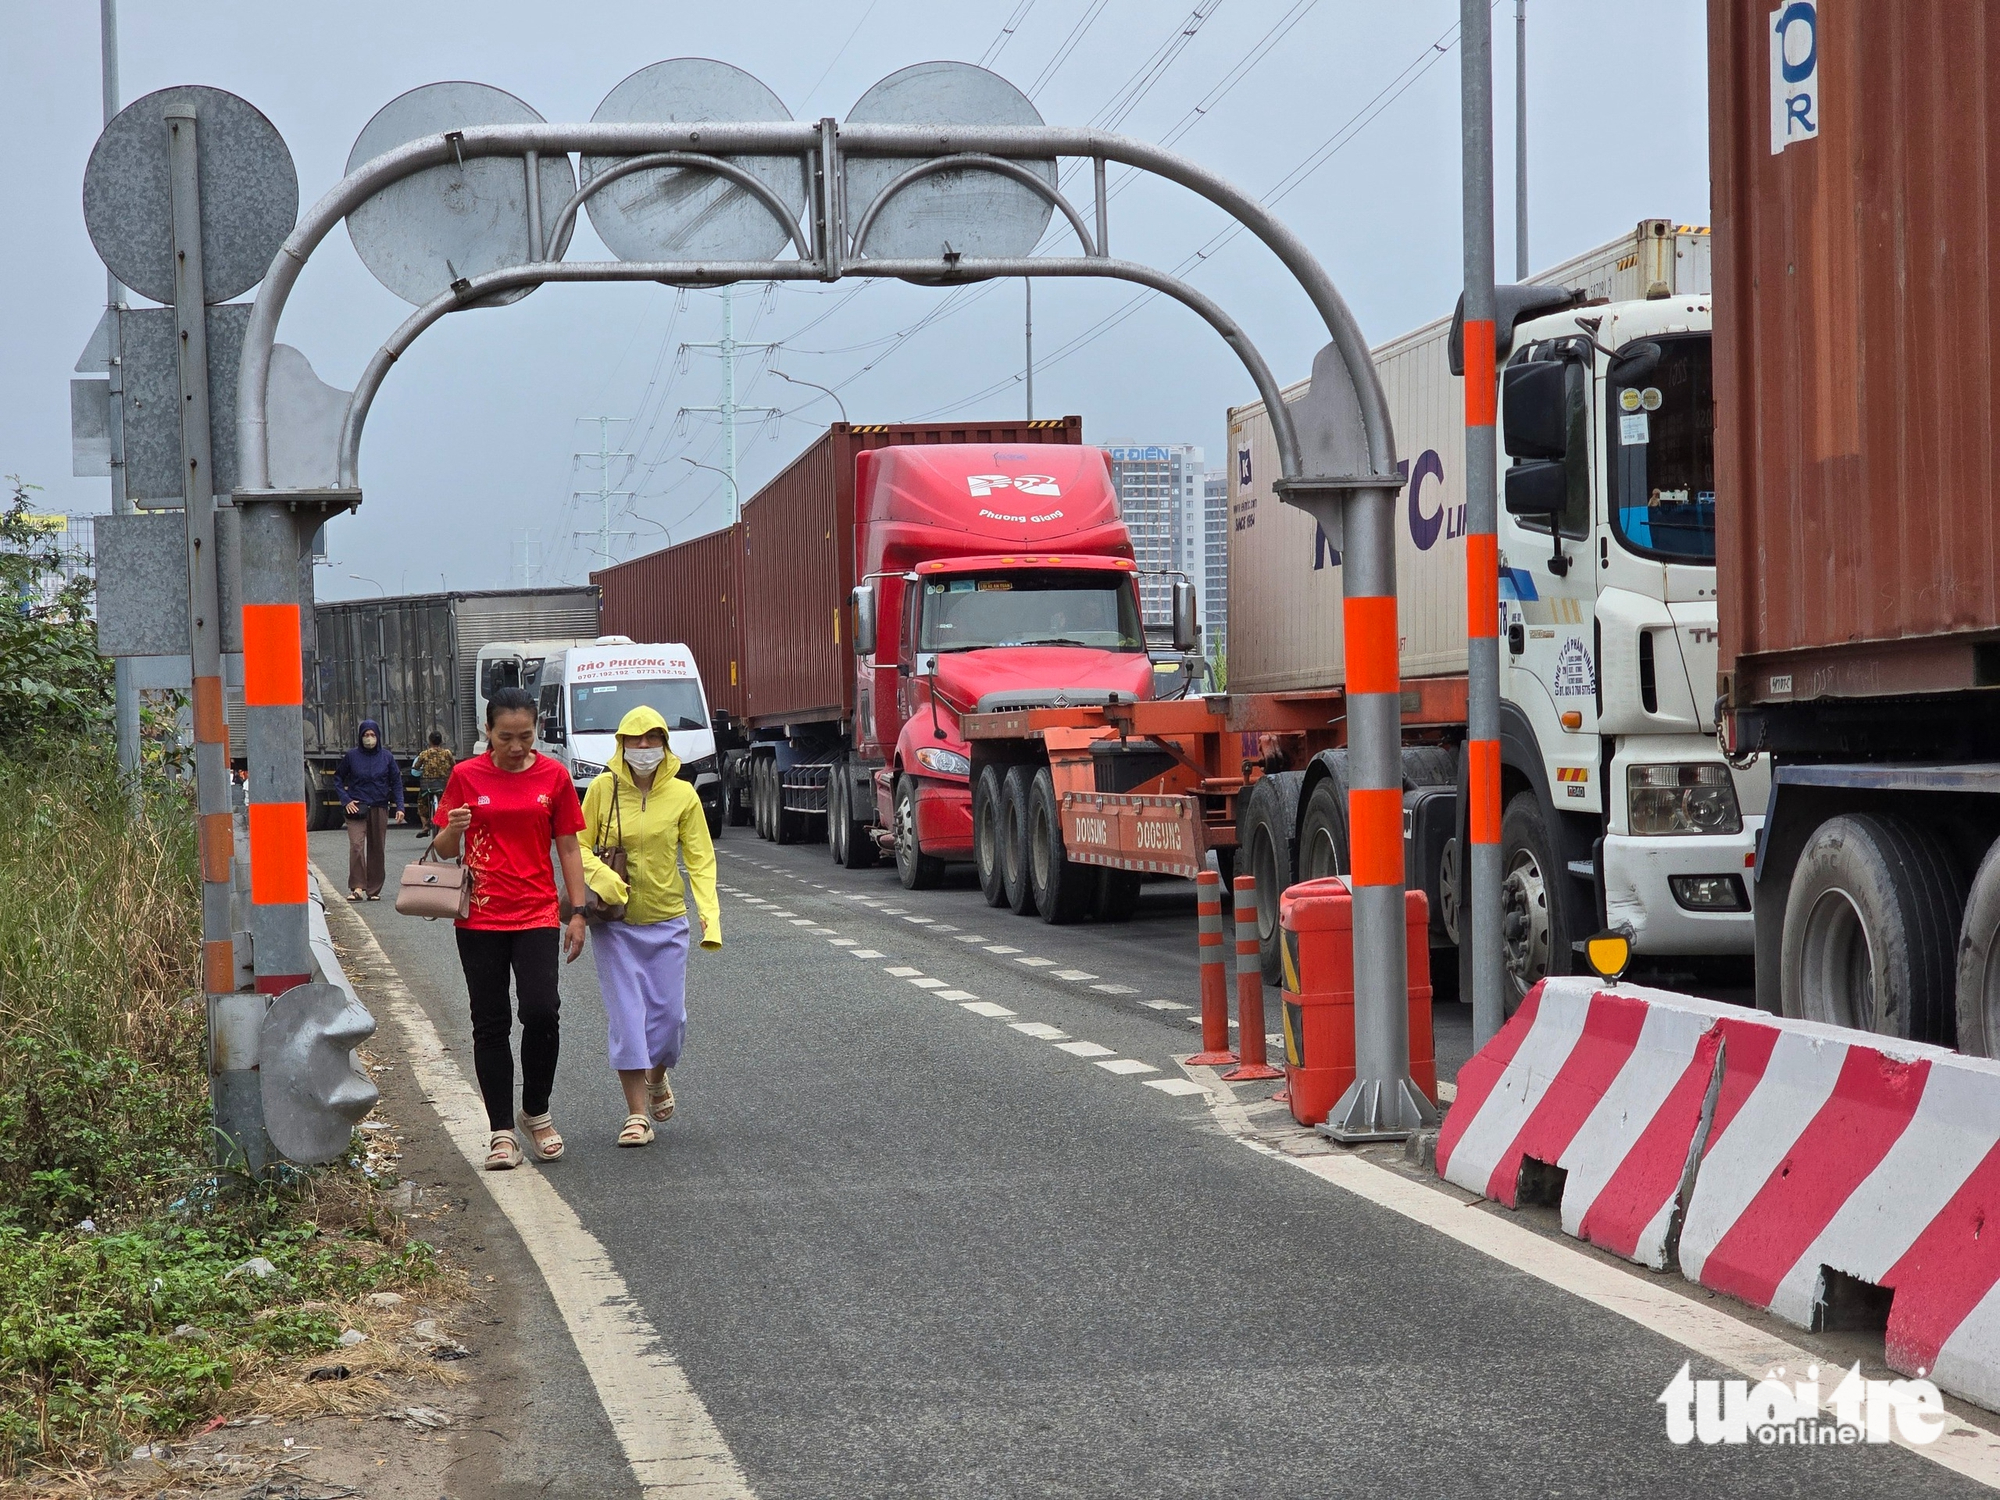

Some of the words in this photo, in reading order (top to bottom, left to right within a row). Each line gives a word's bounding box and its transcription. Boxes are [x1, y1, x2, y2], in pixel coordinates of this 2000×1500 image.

[979, 508, 1026, 523] Phuong
[1030, 510, 1063, 523] Giang
[578, 670, 629, 680] 0707.192.192
